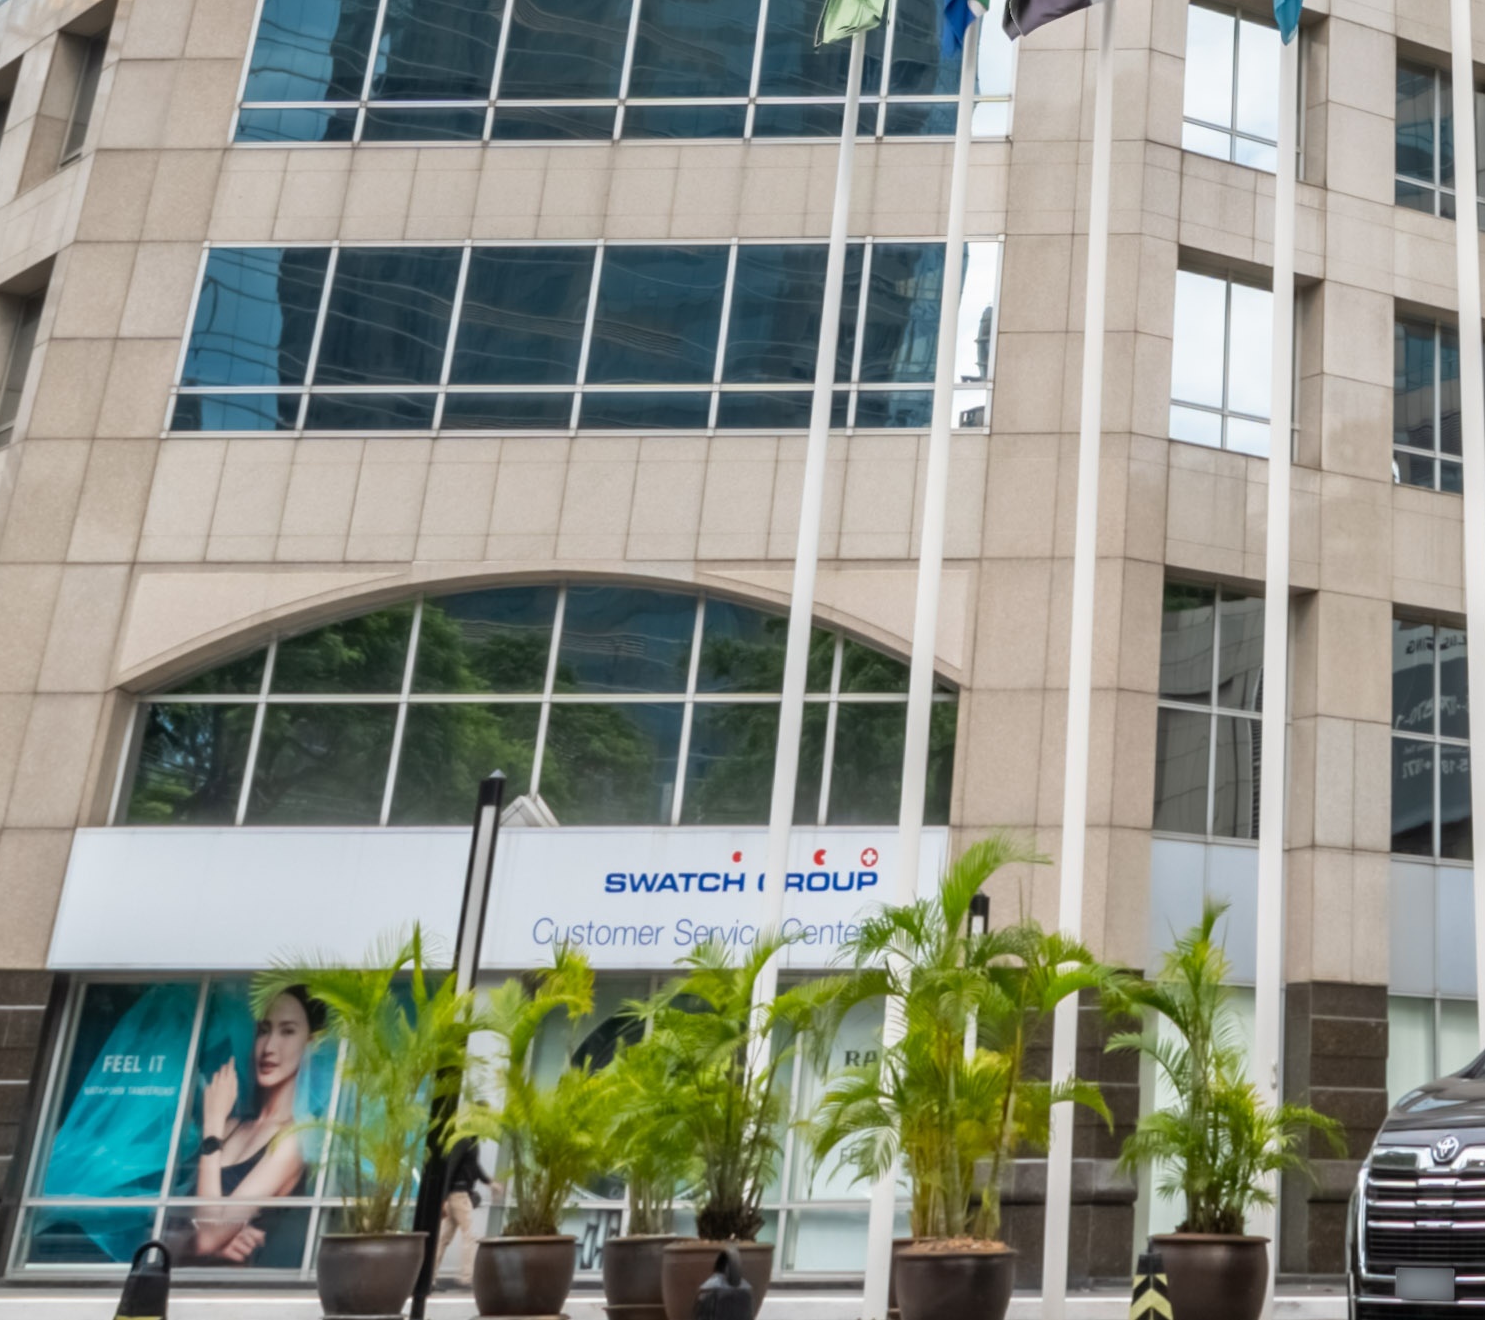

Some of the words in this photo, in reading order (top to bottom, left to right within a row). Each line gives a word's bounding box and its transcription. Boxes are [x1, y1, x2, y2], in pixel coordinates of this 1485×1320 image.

[604, 872, 746, 893] SWATCH
[532, 917, 664, 946] Customer
[674, 918, 762, 946] Servic
[781, 917, 865, 945] Cente
[101, 1054, 142, 1073] FEEL
[148, 1054, 166, 1073] IT
